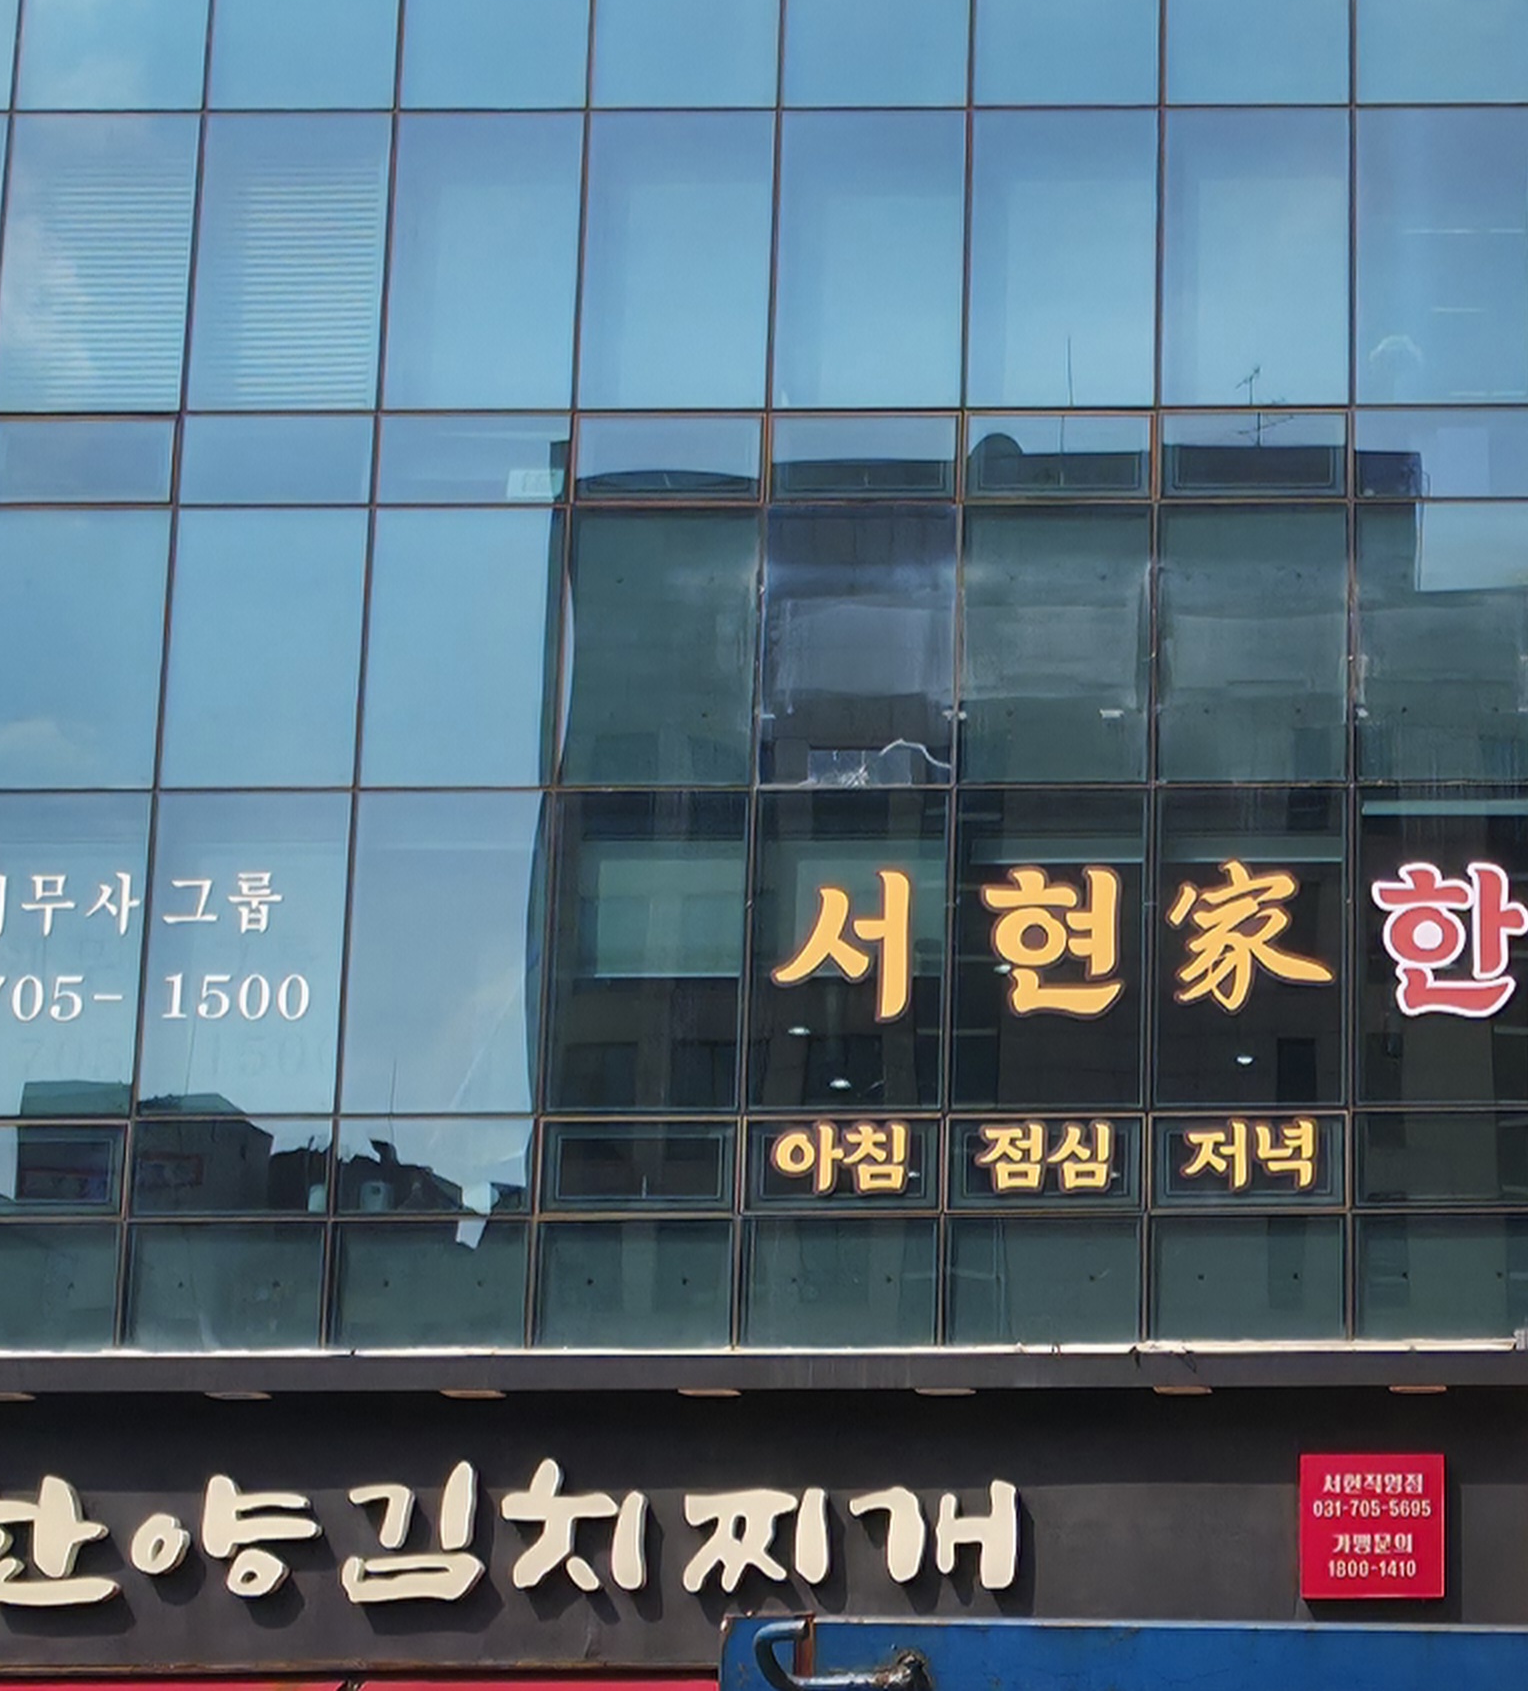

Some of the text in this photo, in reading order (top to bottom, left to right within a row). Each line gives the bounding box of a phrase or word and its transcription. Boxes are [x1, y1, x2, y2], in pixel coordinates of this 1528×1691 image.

[162, 870, 284, 936] 그룹
[771, 1119, 912, 1195] 아침
[975, 1121, 1113, 1194] 점심
[1179, 1116, 1318, 1192] 저녁
[1322, 1473, 1425, 1495] 서현직영점
[1312, 1499, 1432, 1518] 031-705-5695
[1331, 1532, 1415, 1555] 가맹문의
[1327, 1559, 1417, 1578] 1800-1410
